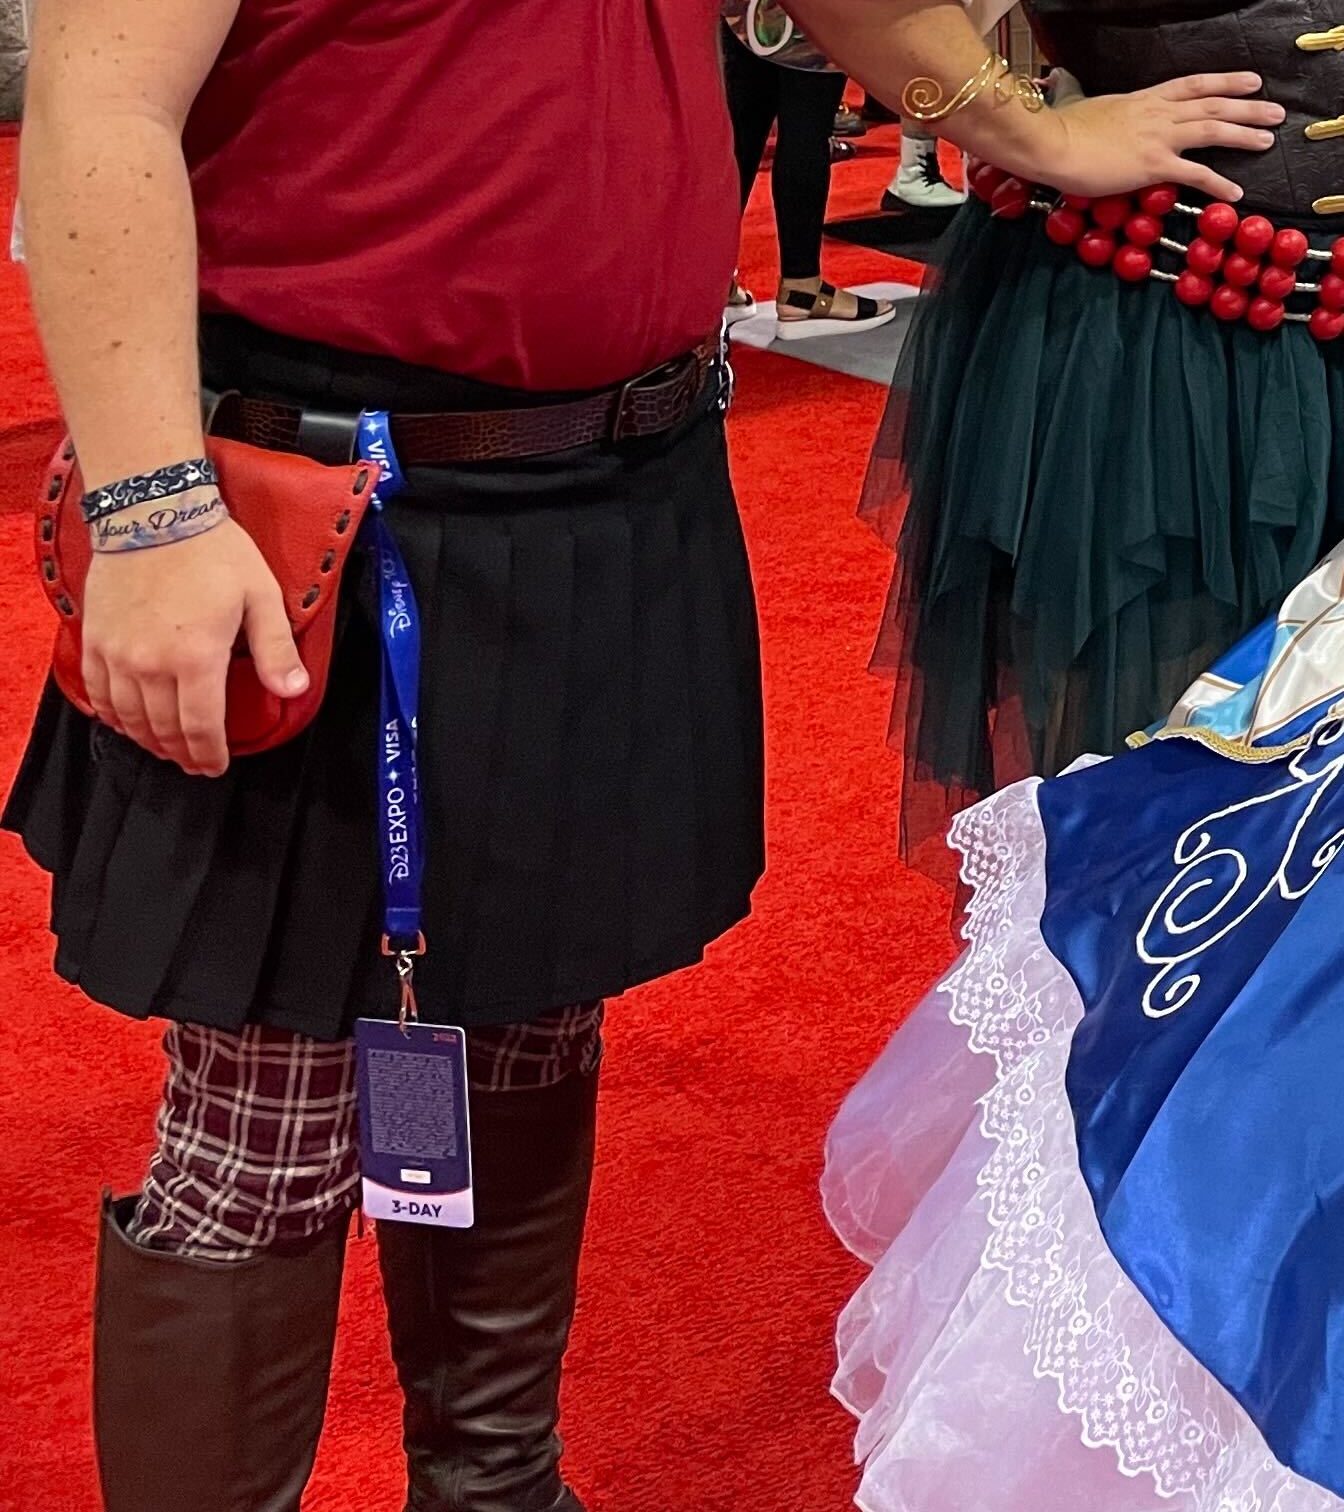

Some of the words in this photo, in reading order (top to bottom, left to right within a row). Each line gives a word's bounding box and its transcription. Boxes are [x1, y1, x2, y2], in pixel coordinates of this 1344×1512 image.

[96, 517, 144, 547] Your
[385, 718, 401, 763] VISA
[391, 1199, 443, 1219] 3-DAY
